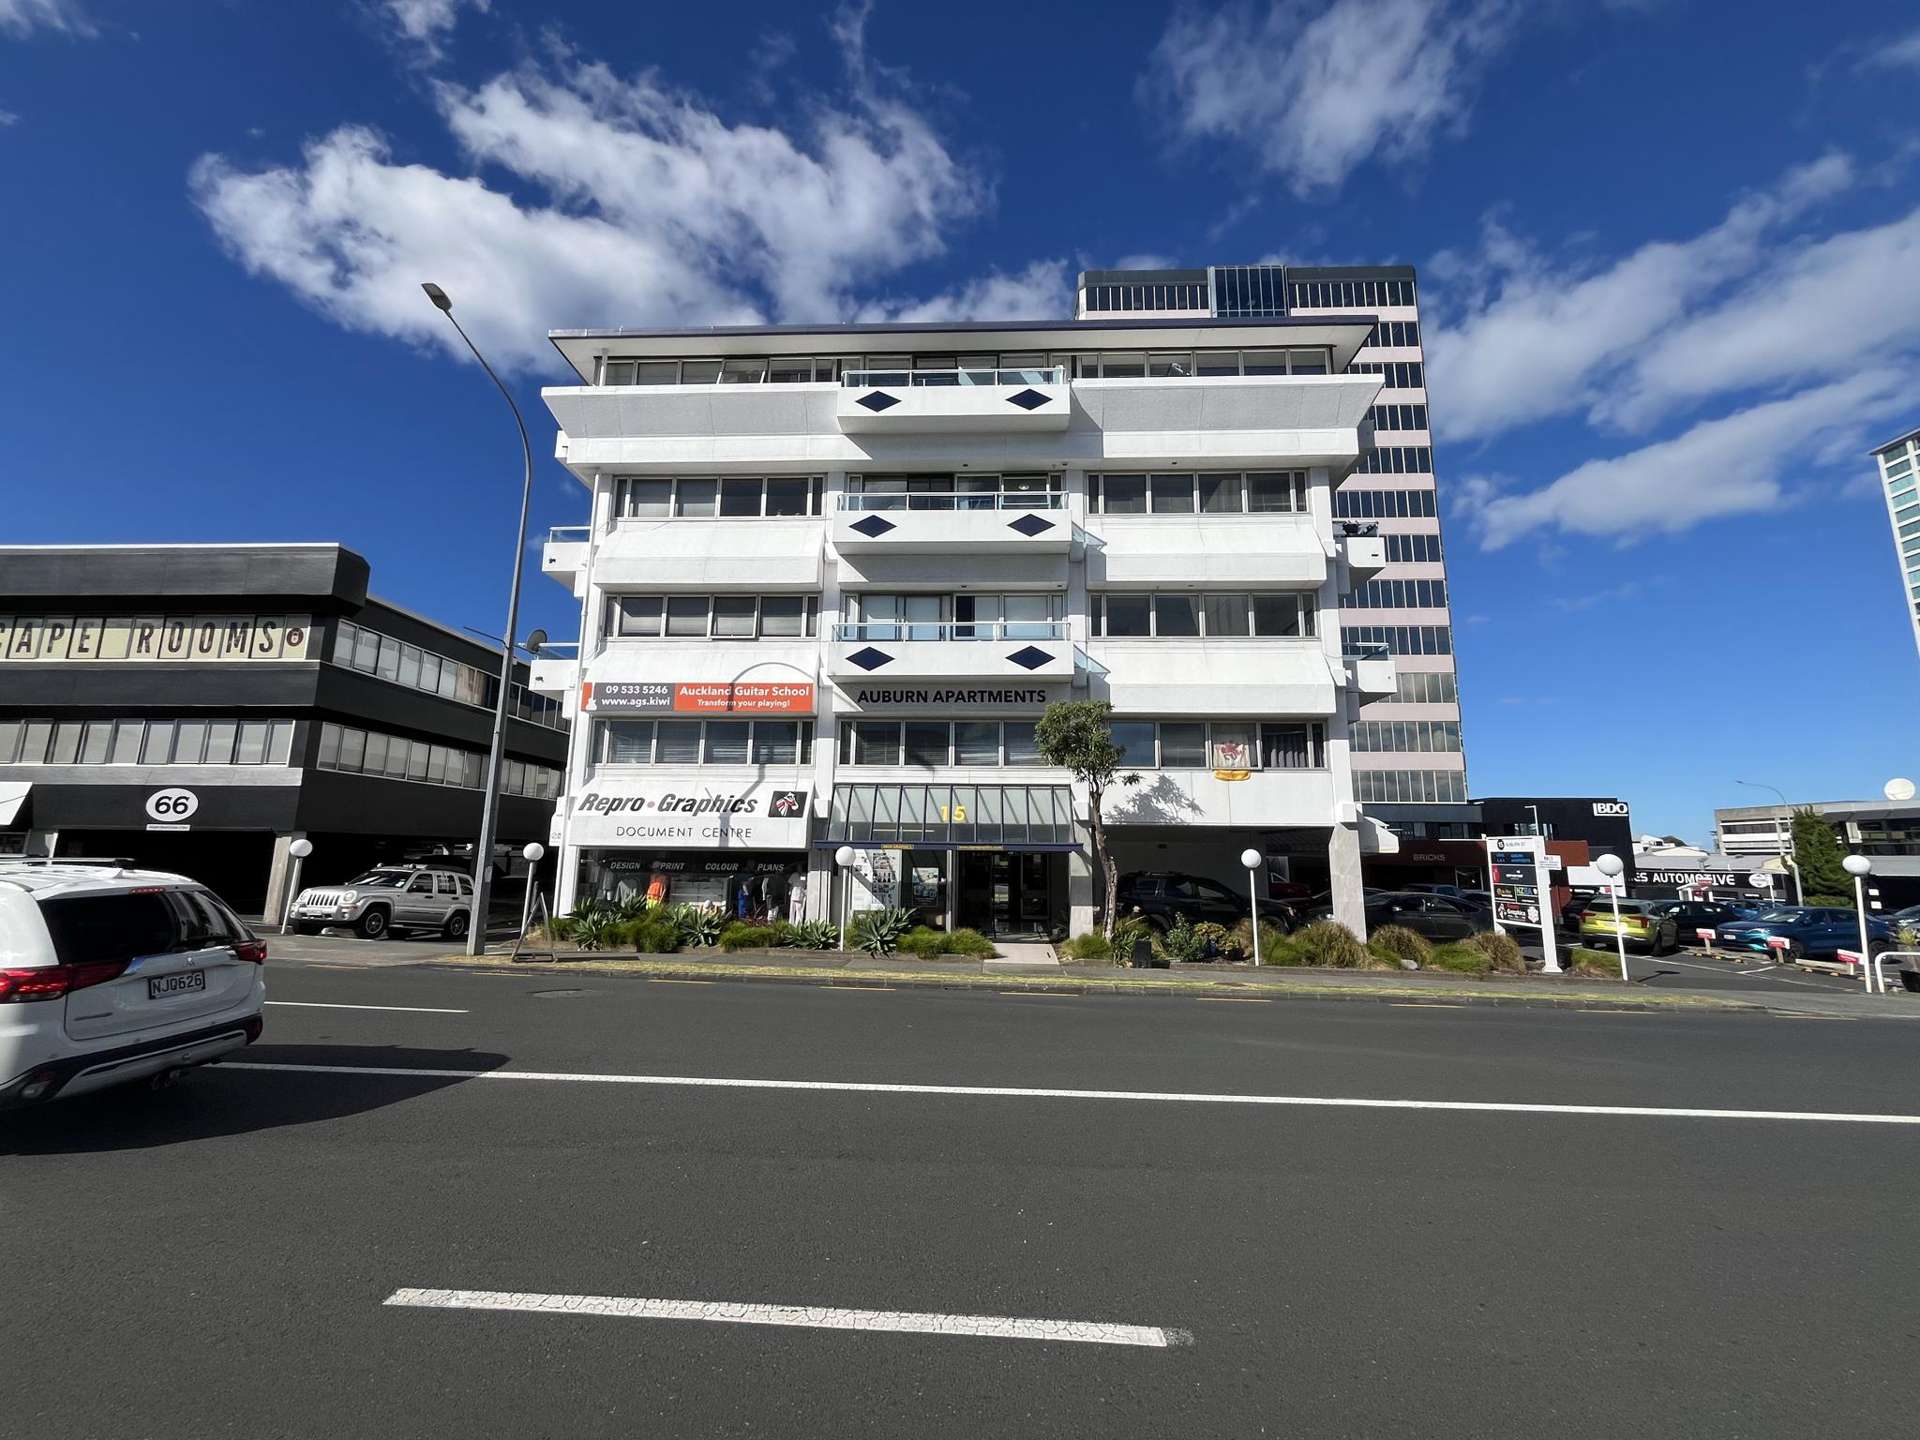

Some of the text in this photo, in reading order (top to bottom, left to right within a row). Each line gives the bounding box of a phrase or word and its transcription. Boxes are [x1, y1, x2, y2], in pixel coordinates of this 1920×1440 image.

[136, 620, 278, 654] ROOMS
[605, 685, 668, 695] 09 533 5246
[679, 685, 810, 697] Auckland Guitar School
[857, 690, 1047, 704] AUBURN APARTMENTS
[601, 696, 671, 708] www.ags.kiwi
[697, 698, 791, 709] Transform your playing!
[154, 795, 190, 815] 66
[578, 792, 758, 817] Repro Graphics
[1597, 801, 1628, 815] BDO
[940, 804, 966, 821] 15
[616, 825, 753, 839] DOCUMENT CENTRE
[610, 861, 785, 872] DESIGN PRINT COLOUR PLANS
